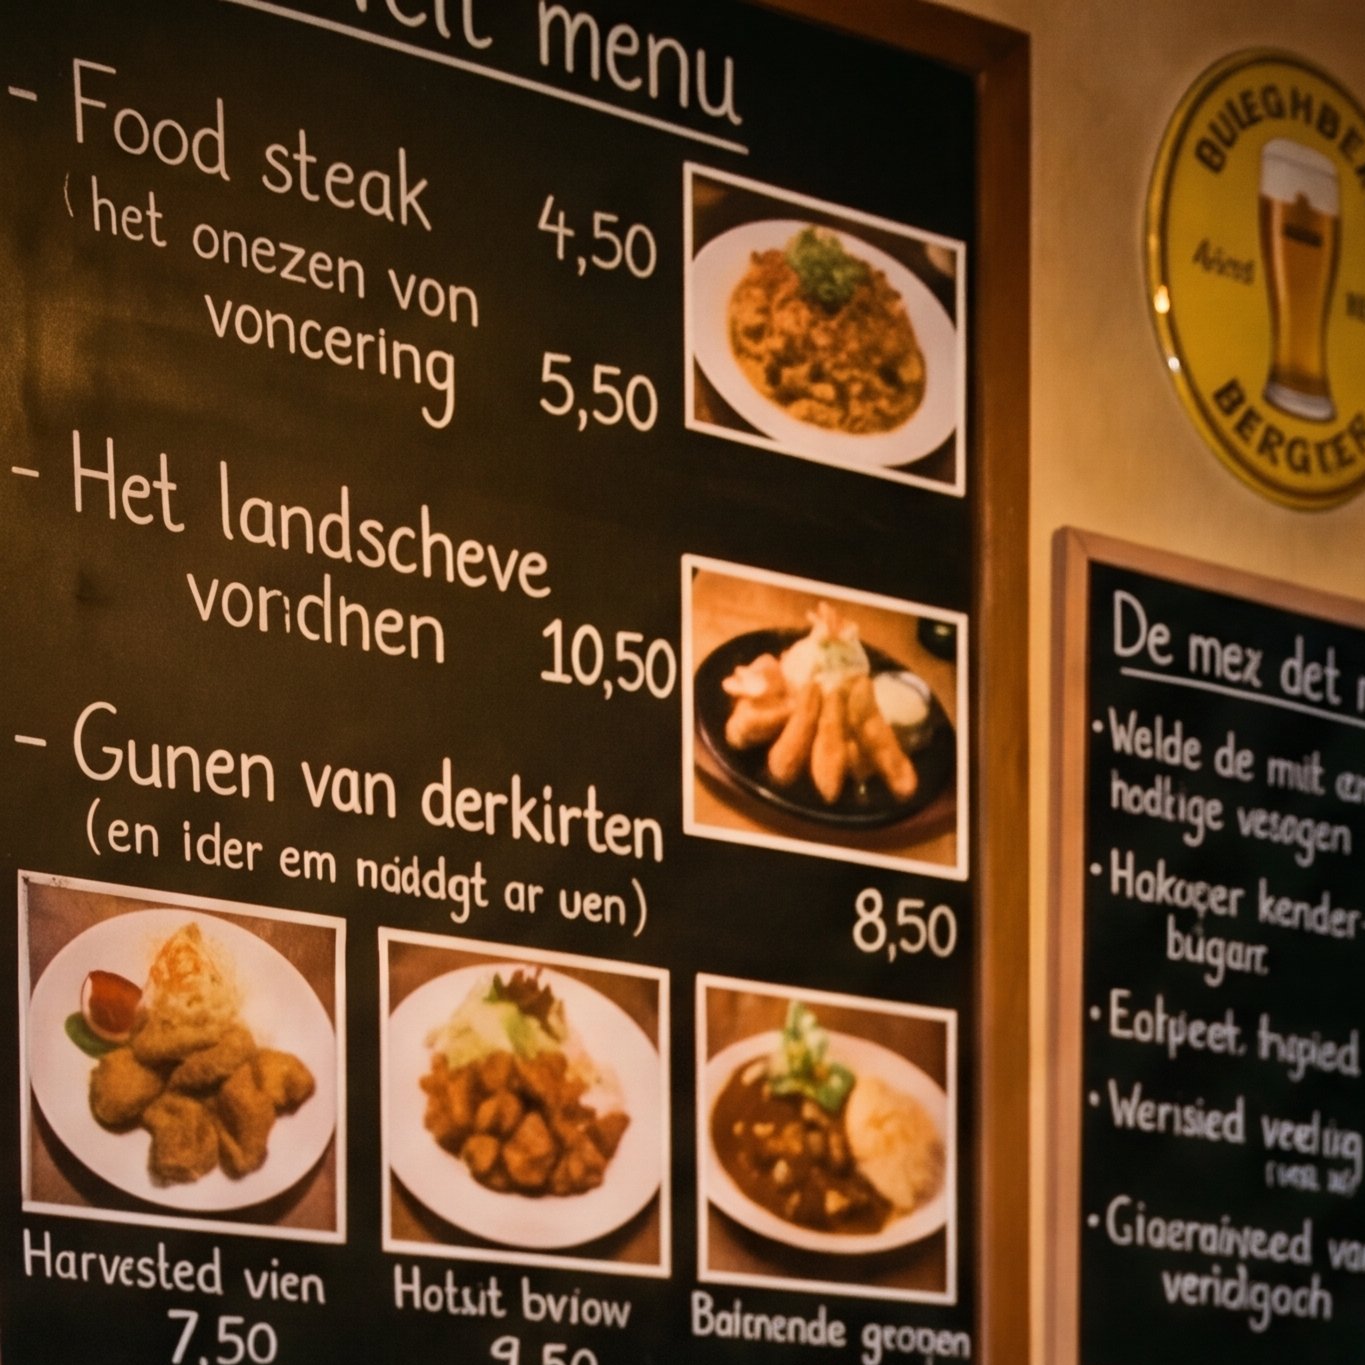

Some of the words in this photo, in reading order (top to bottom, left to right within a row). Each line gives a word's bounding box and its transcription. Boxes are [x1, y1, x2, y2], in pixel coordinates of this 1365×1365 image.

[539, 0, 743, 125] menu
[73, 57, 230, 181] Food
[262, 129, 431, 231] steak
[537, 195, 657, 279] 4,50
[192, 222, 365, 299] onezen
[387, 268, 479, 328] von
[204, 294, 456, 429] voncering
[539, 352, 659, 432] 5,50
[72, 429, 185, 533] Het
[219, 460, 552, 599] landscheve
[540, 618, 678, 699] 10,50
[1113, 588, 1174, 666] De
[1280, 633, 1342, 706] det
[73, 701, 275, 802] Gunen
[301, 760, 397, 818] van
[421, 757, 664, 863] derkirten
[1108, 706, 1202, 771] Welde
[1214, 730, 1255, 782] de
[86, 798, 160, 857] (en
[182, 820, 263, 871] ider
[279, 847, 337, 884] em
[852, 887, 958, 963] 8,50
[22, 1228, 225, 1296] Harvested
[243, 1257, 326, 1305] vien
